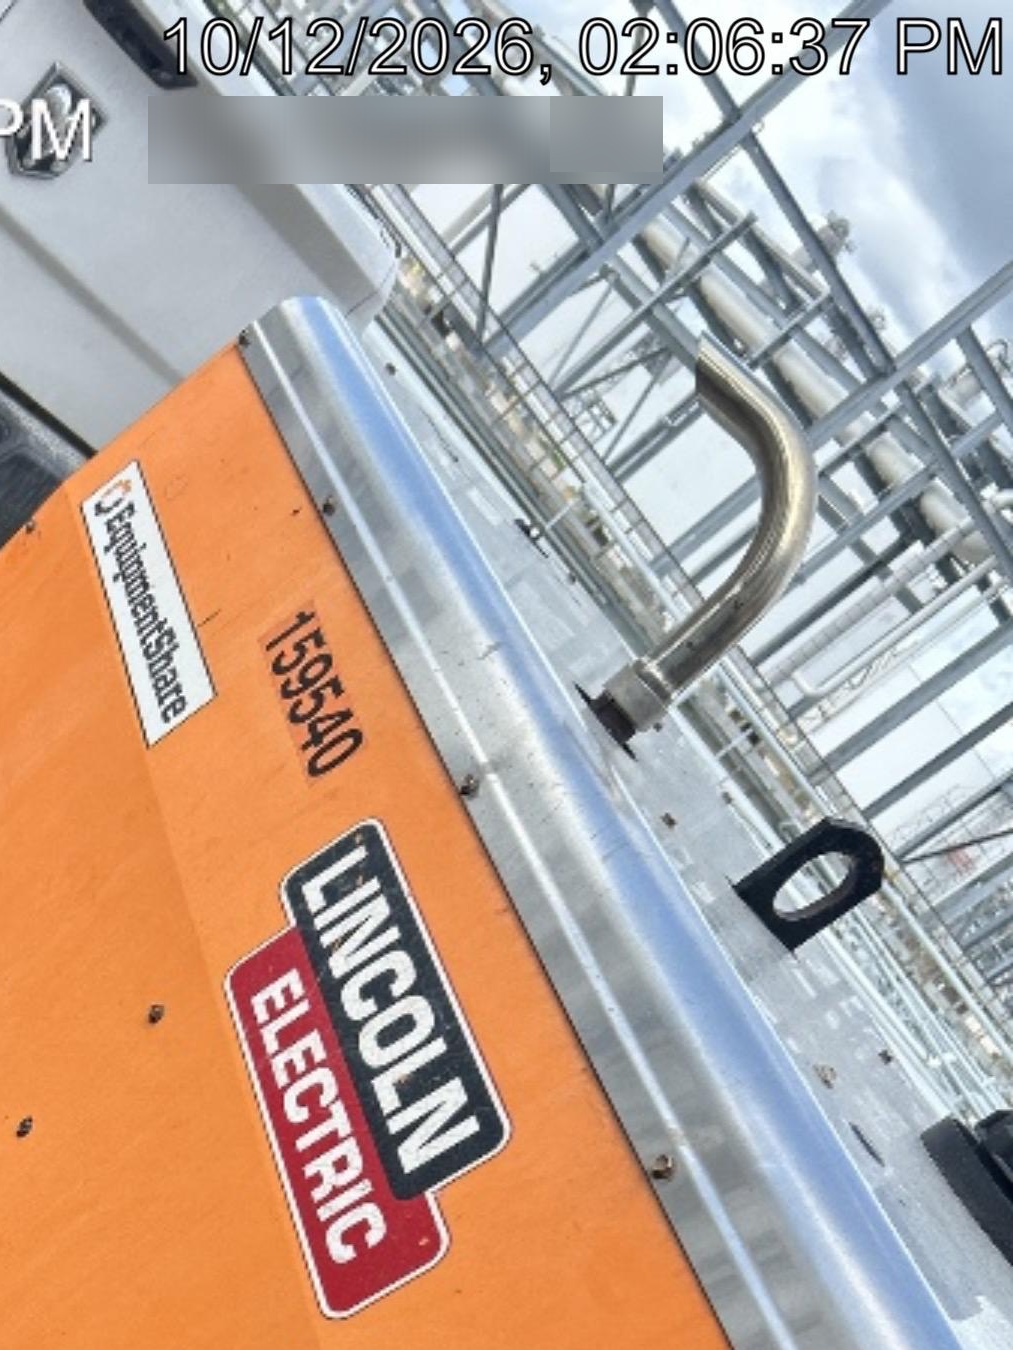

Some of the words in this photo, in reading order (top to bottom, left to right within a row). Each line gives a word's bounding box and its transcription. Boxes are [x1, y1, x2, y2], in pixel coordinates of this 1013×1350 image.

[103, 502, 188, 724] EquipmentShare
[264, 609, 364, 778] 159540
[250, 967, 387, 1265] ELECTRIC
[300, 845, 481, 1175] LINCOLN
